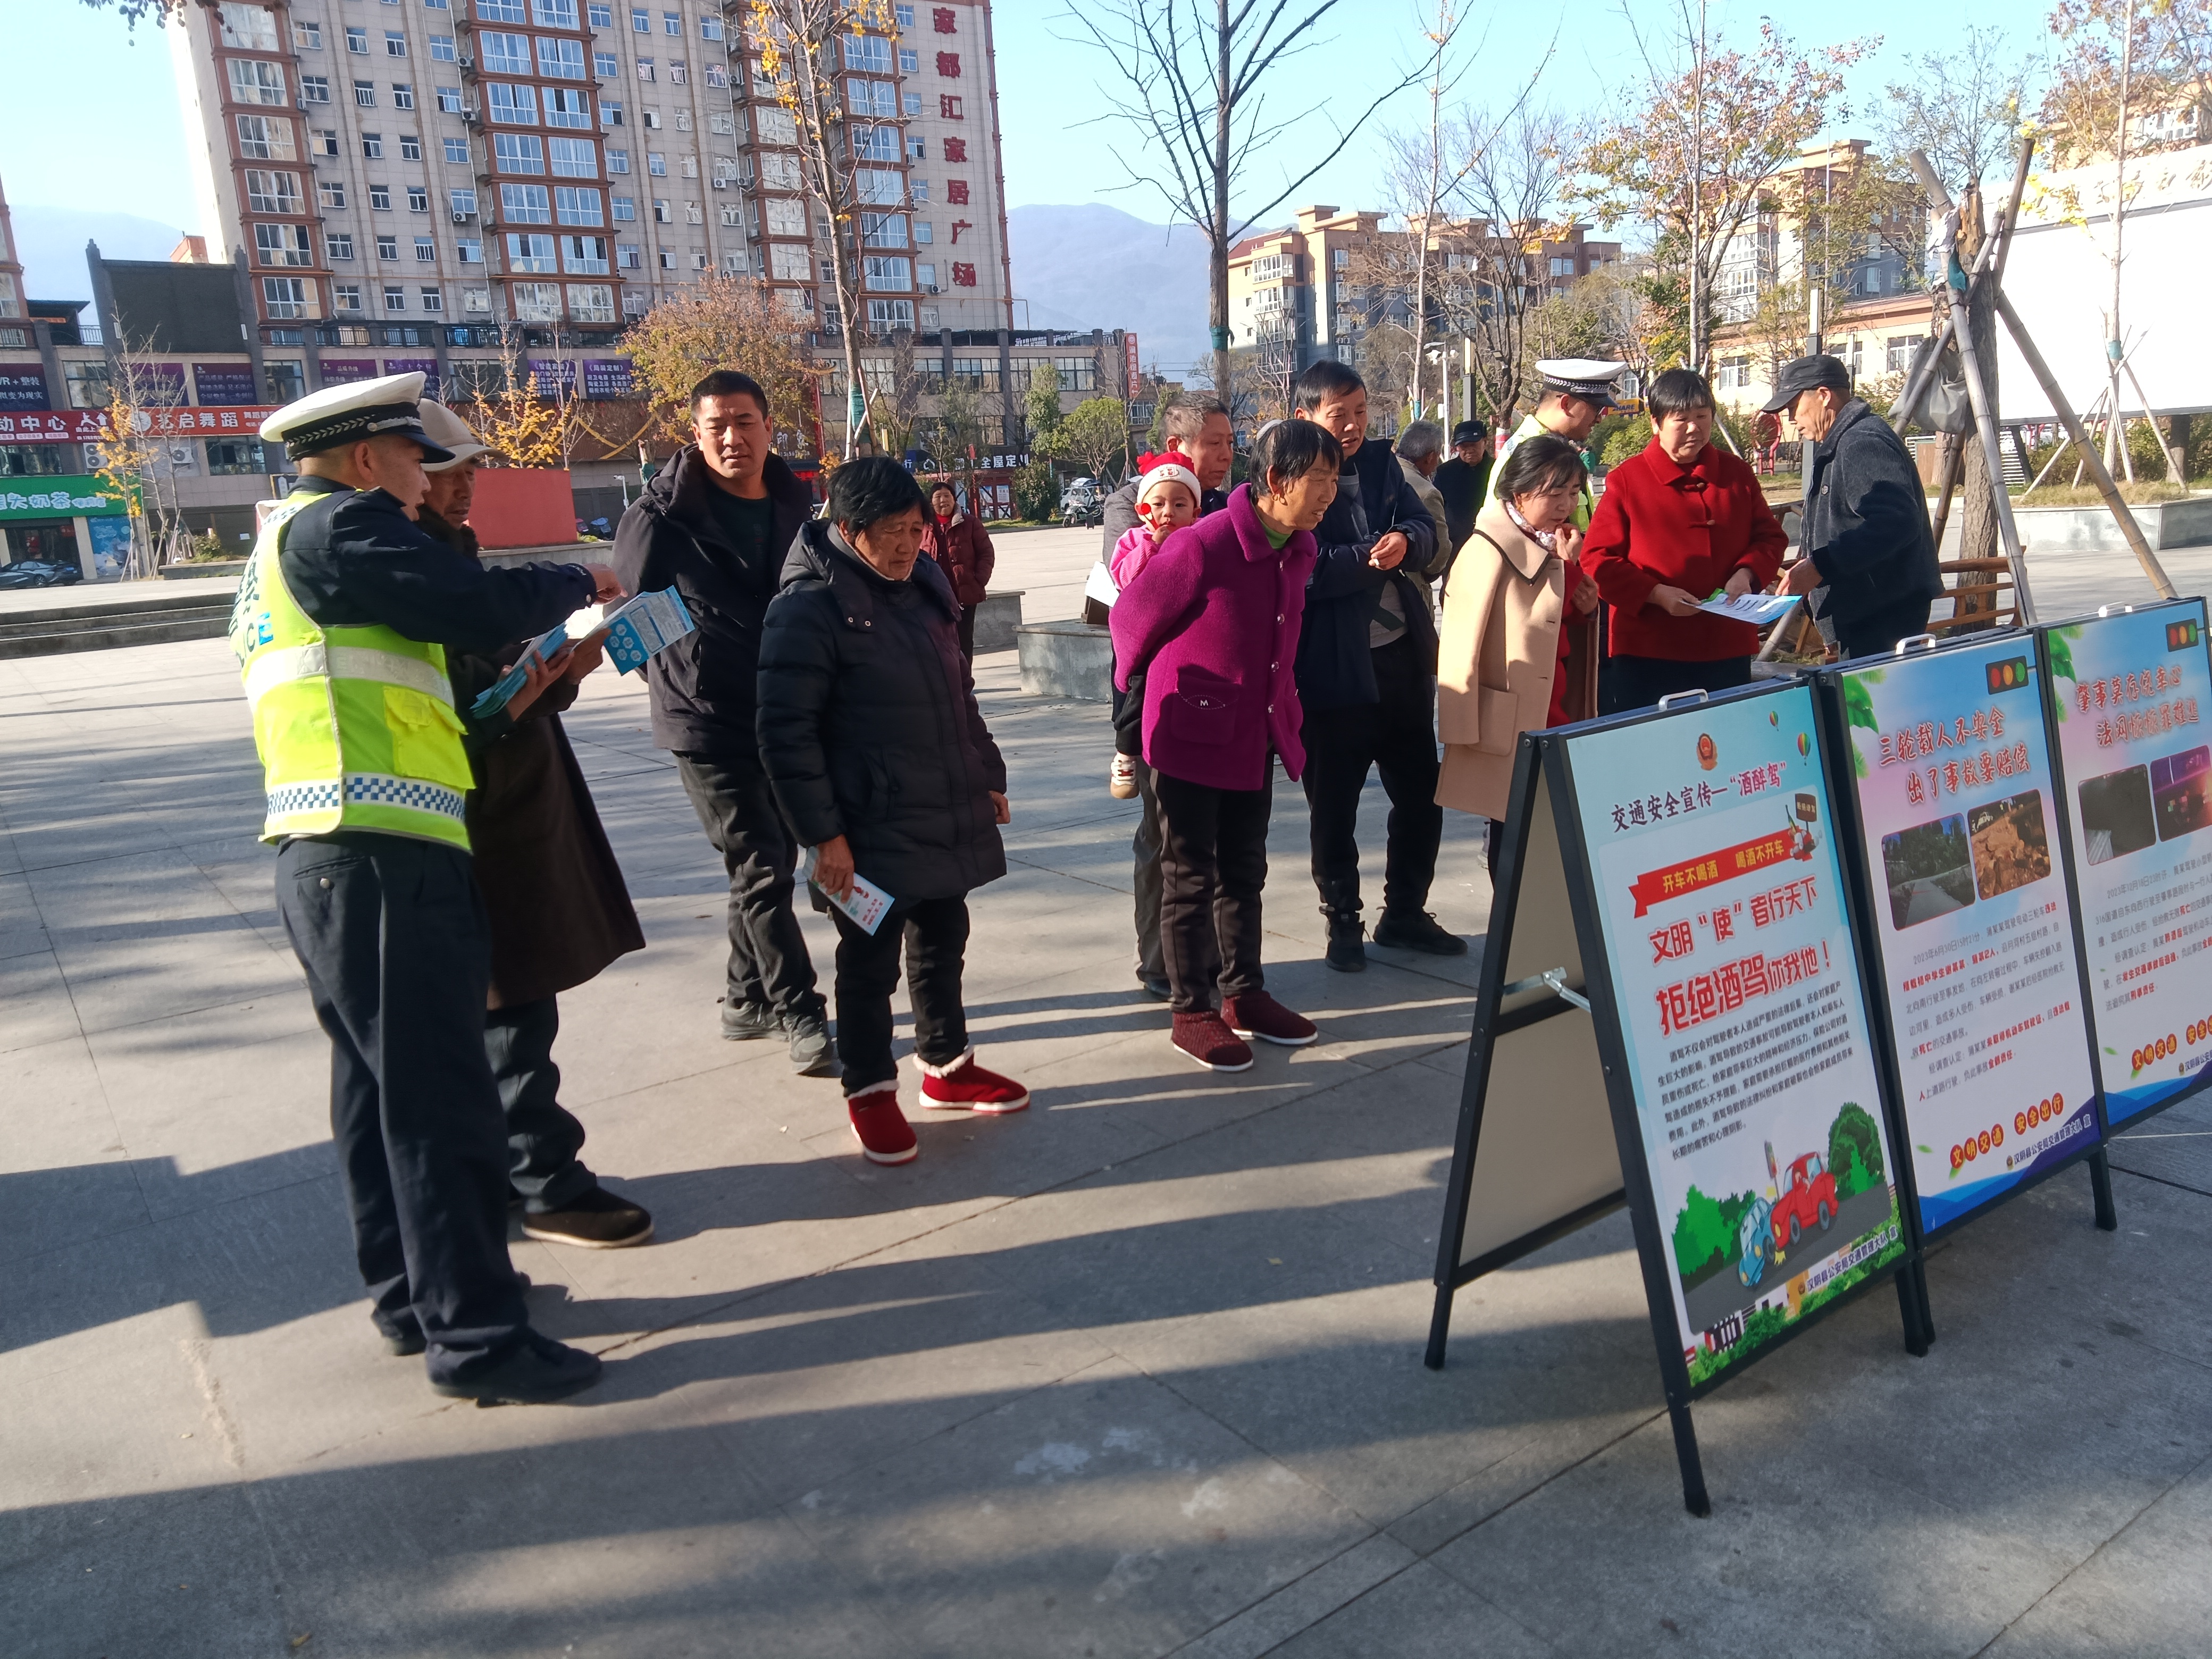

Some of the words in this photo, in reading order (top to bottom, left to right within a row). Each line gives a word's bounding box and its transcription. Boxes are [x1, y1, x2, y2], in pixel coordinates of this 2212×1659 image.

[933, 7, 976, 287] 家都汇家居广场
[1875, 704, 2006, 767] 三轮载人不安全
[1905, 741, 2029, 805] 出了事故要赔偿
[1661, 859, 1719, 894] 开车不喝酒
[1735, 838, 1785, 870] 喝酒不开车
[1655, 940, 1830, 1037] 拒绝酒驾你我他！
[2133, 1036, 2175, 1067] 文明交通
[1953, 1127, 2002, 1166] 文明交通
[2016, 1095, 2062, 1133] 安全出行
[2013, 1119, 2082, 1165] 汉阴县公安局交通管理大队
[1807, 1231, 1888, 1292] 汉阴县公安局交通管理大队
